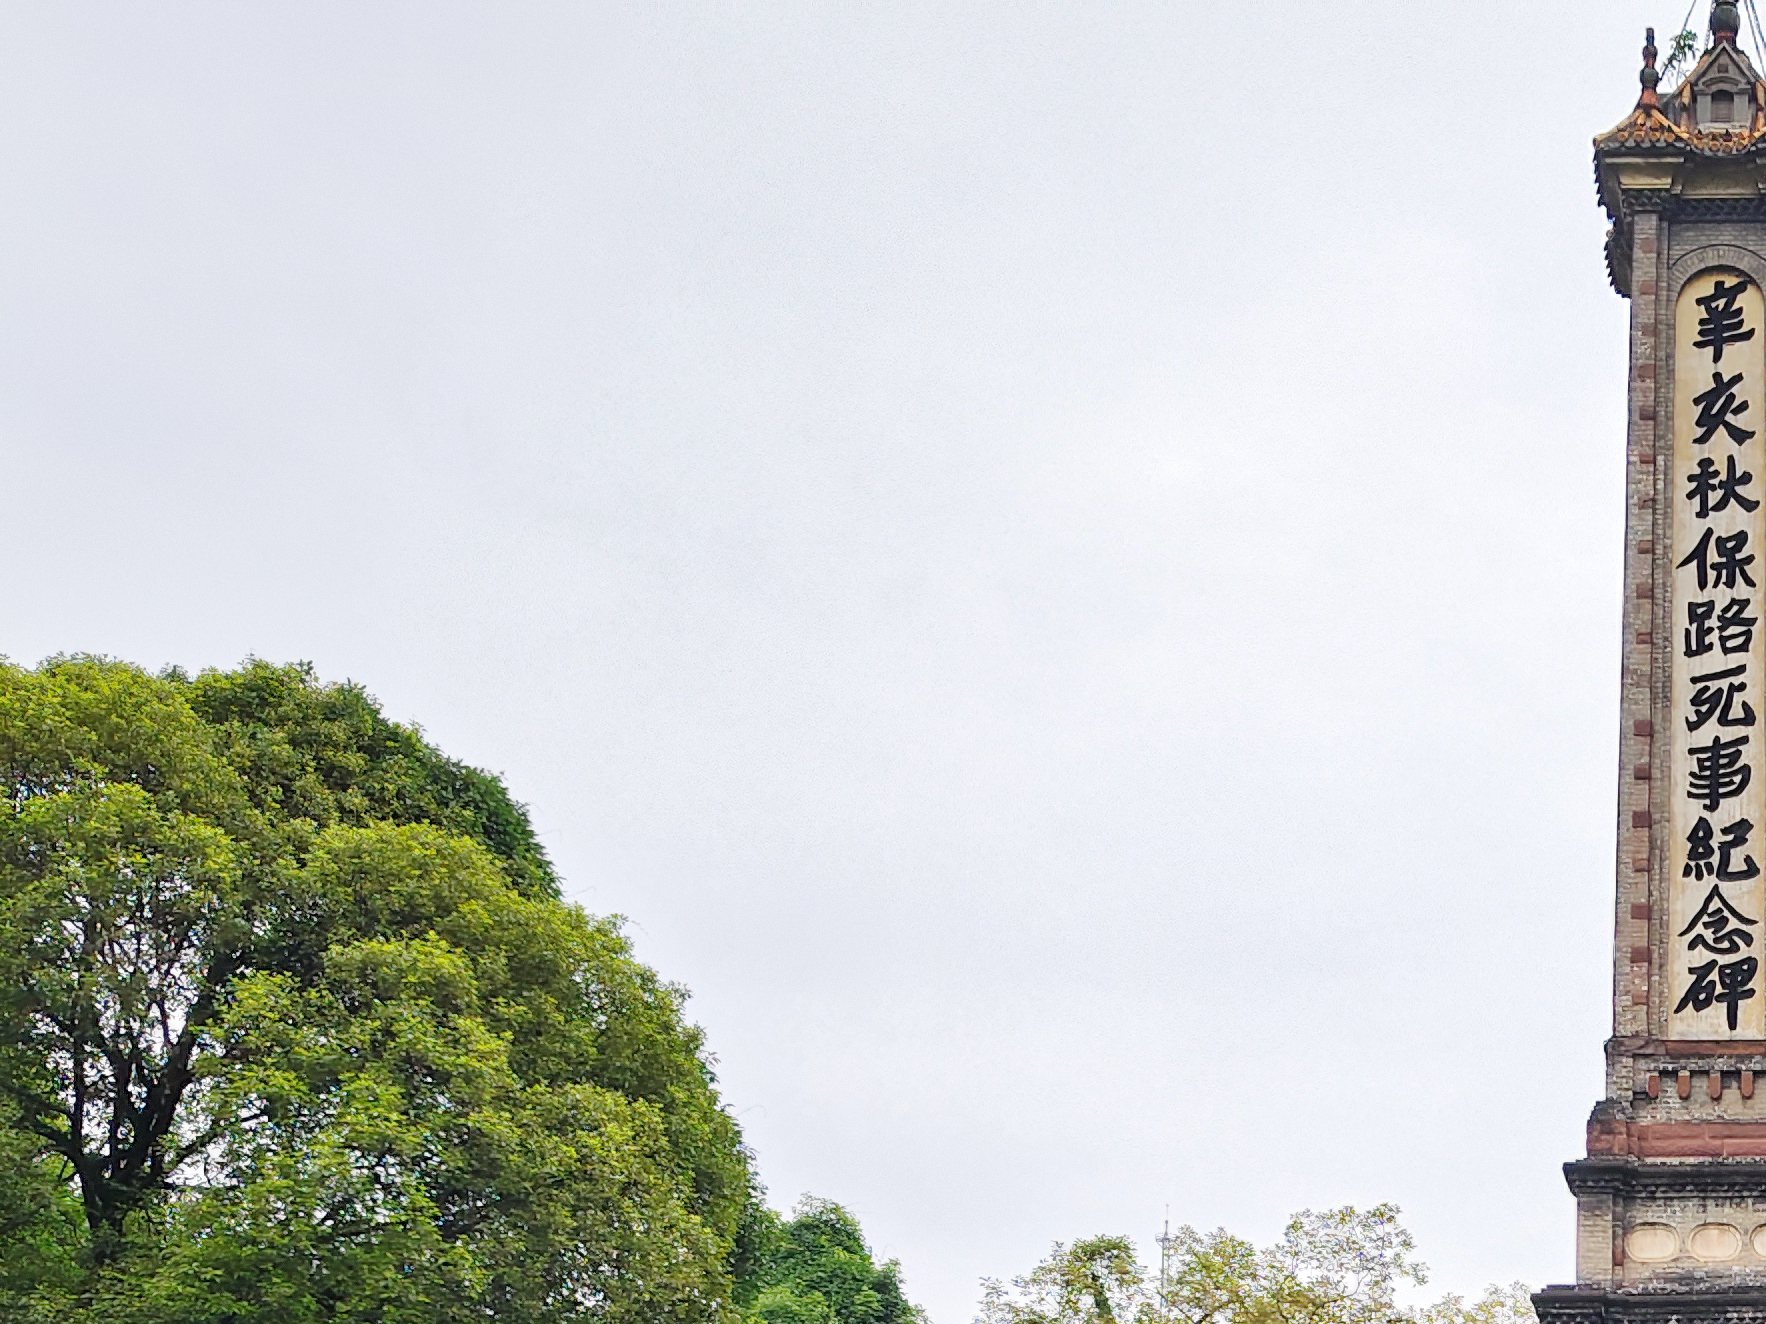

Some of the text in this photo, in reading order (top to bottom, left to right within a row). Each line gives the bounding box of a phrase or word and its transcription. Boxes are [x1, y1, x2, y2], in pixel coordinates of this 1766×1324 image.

[1674, 279, 1760, 1031] 辛亥秋保路死事紀念碑
